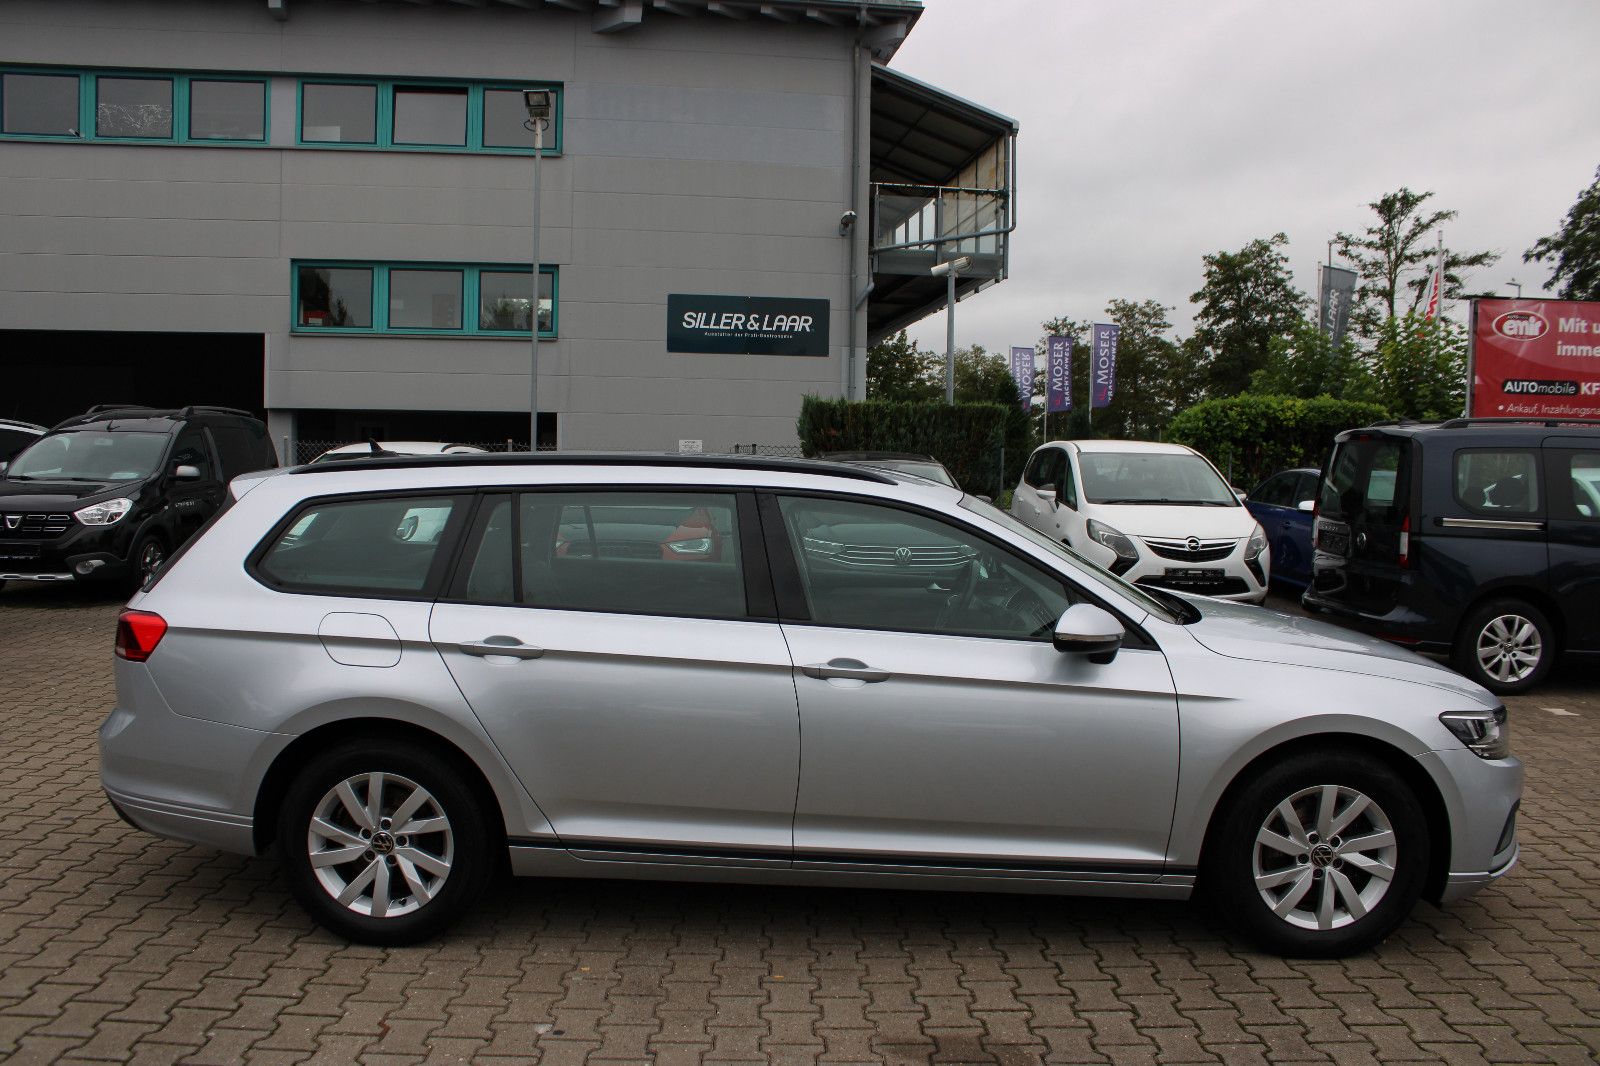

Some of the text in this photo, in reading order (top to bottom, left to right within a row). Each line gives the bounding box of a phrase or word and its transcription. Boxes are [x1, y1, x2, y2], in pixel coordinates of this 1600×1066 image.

[682, 312, 813, 332] SILLER & LAAR
[1559, 317, 1588, 333] Mit
[1556, 340, 1600, 357] imme
[1052, 341, 1064, 391] MOSER
[1097, 330, 1110, 385] MOSER
[1504, 381, 1600, 395] AUTOmobile KF
[1506, 403, 1539, 414] Ankauf,
